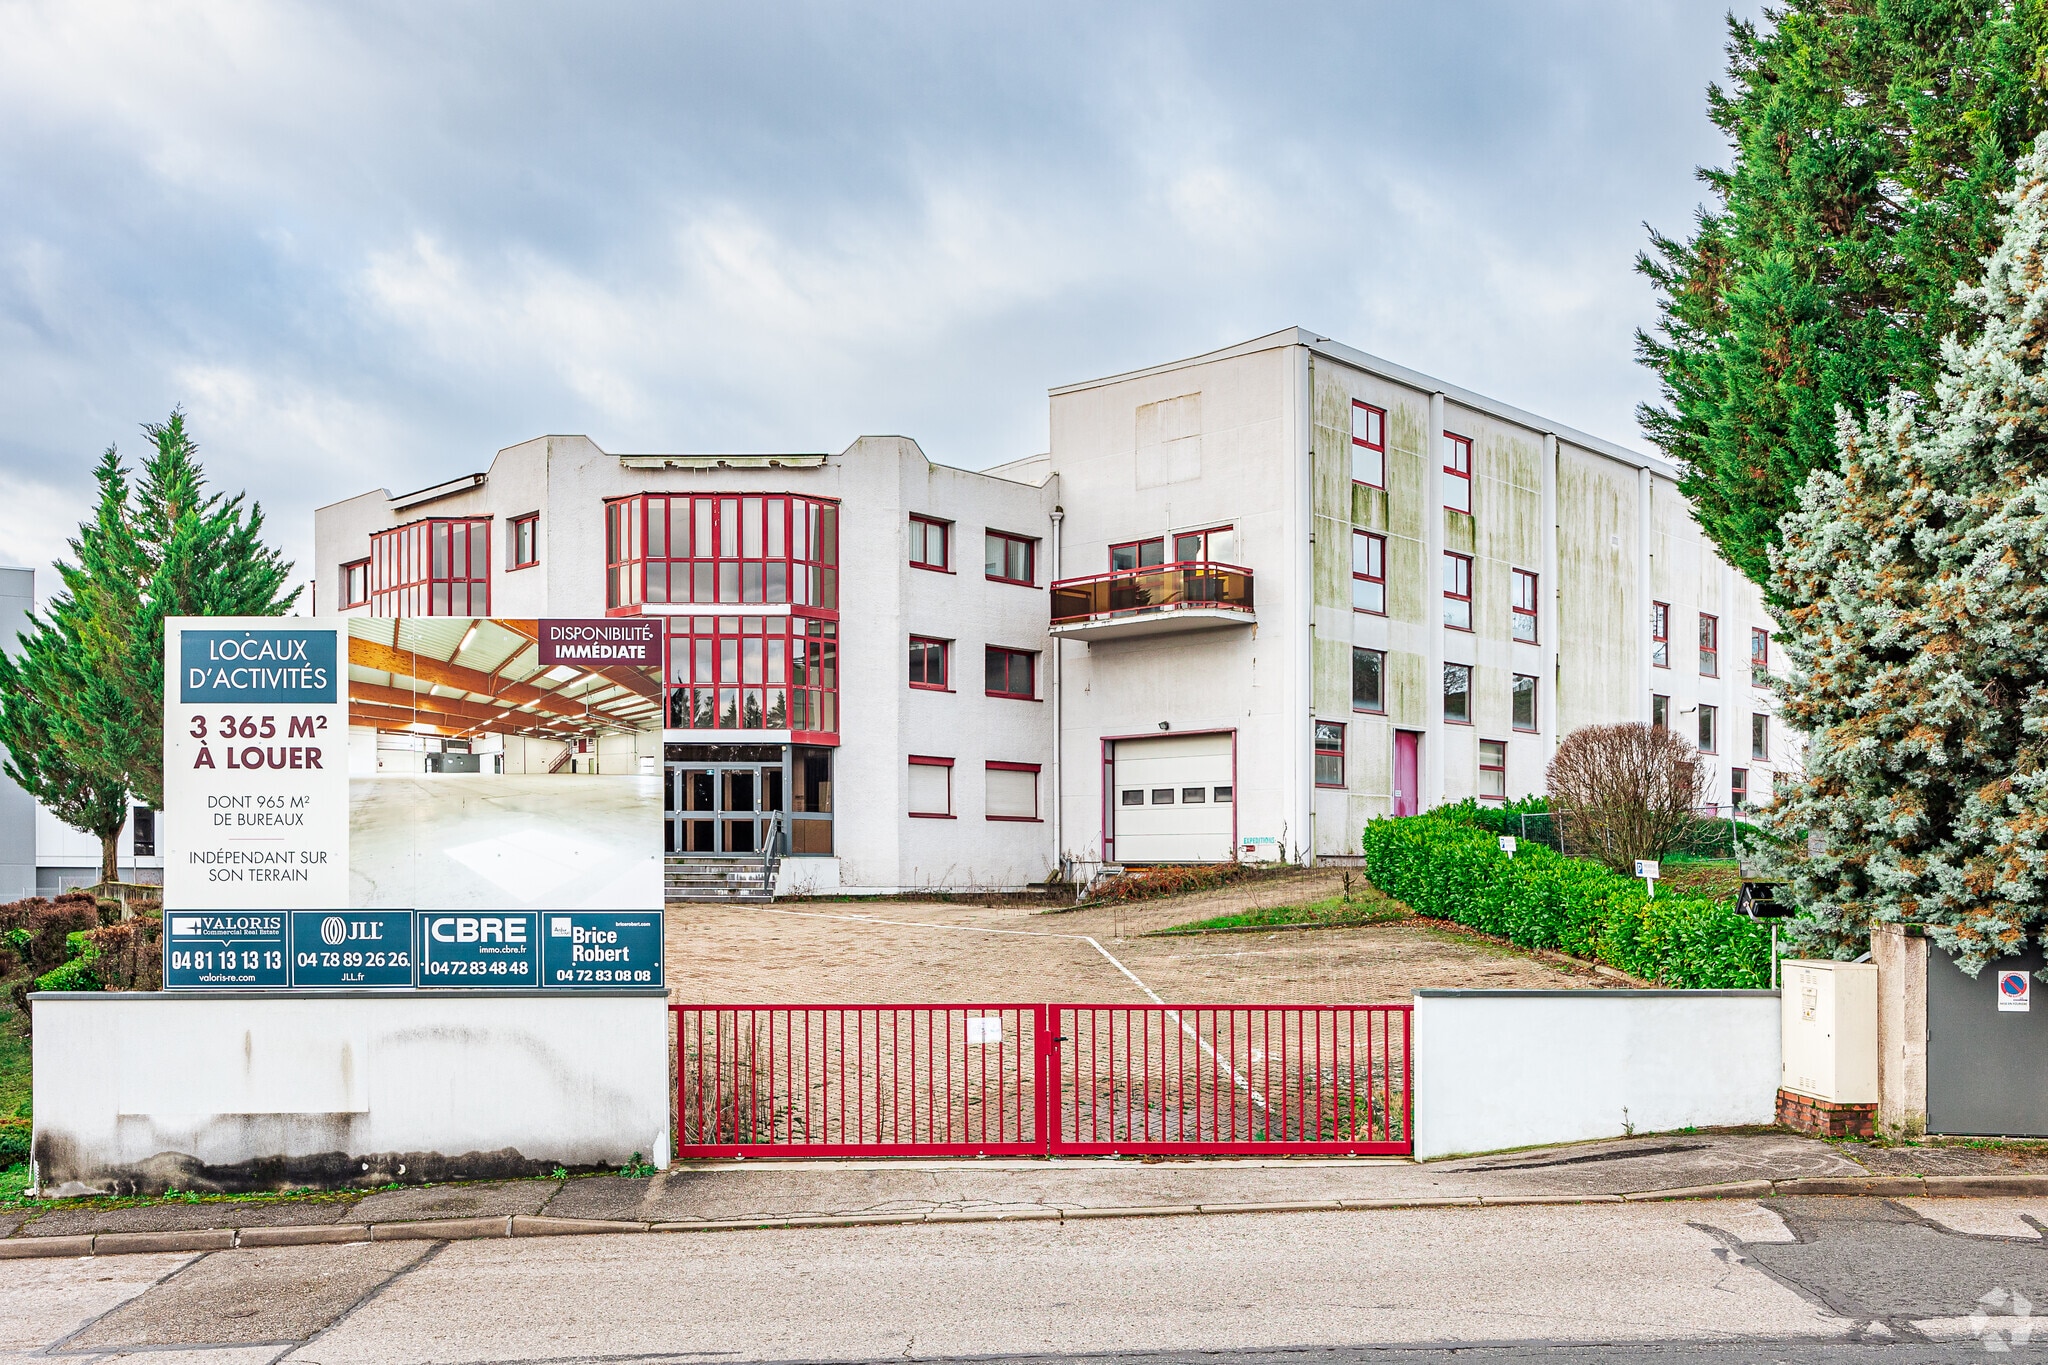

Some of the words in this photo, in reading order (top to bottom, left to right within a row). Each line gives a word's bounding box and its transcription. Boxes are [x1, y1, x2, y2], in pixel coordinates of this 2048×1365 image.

[550, 623, 651, 641] DISPONIBILITÉ
[209, 639, 308, 662] LOCAUX
[555, 641, 646, 659] IMMÉDIATE
[189, 714, 208, 739] 3
[219, 714, 276, 739] 365
[288, 714, 328, 739] M²
[193, 739, 216, 770] À
[226, 746, 324, 770] LOUER
[207, 795, 252, 809] DONT
[256, 795, 285, 809] 965
[290, 795, 310, 809] M²
[213, 813, 232, 826] DE
[237, 813, 304, 826] BUREAUX
[189, 847, 296, 865] INDÉPENDANT
[300, 851, 328, 865] SUR
[208, 868, 243, 882] SON
[248, 868, 308, 882] TERRAIN
[202, 917, 281, 930] VALORIS
[347, 921, 383, 940] JLL
[431, 917, 527, 943] CBRE
[573, 926, 617, 944] Brice
[479, 944, 527, 954] immo.cbre.fr
[573, 944, 630, 962] Robert
[172, 951, 191, 970] 04
[194, 951, 213, 970] 81
[219, 951, 236, 970] 13
[241, 951, 259, 970] 13
[263, 951, 282, 970] 13
[297, 952, 318, 967] 04
[342, 952, 363, 967] 89
[365, 952, 386, 967] 26
[430, 961, 449, 975] 04
[450, 961, 468, 975] 72
[469, 961, 487, 975] 83
[488, 961, 508, 975] 48
[508, 961, 529, 975] 48
[199, 972, 256, 982] valoris-re.com
[341, 972, 365, 982] JLL.fr
[556, 969, 574, 981] 04
[575, 969, 593, 981] 72
[595, 969, 612, 981] 83
[614, 969, 632, 981] 08
[633, 969, 651, 981] 08
